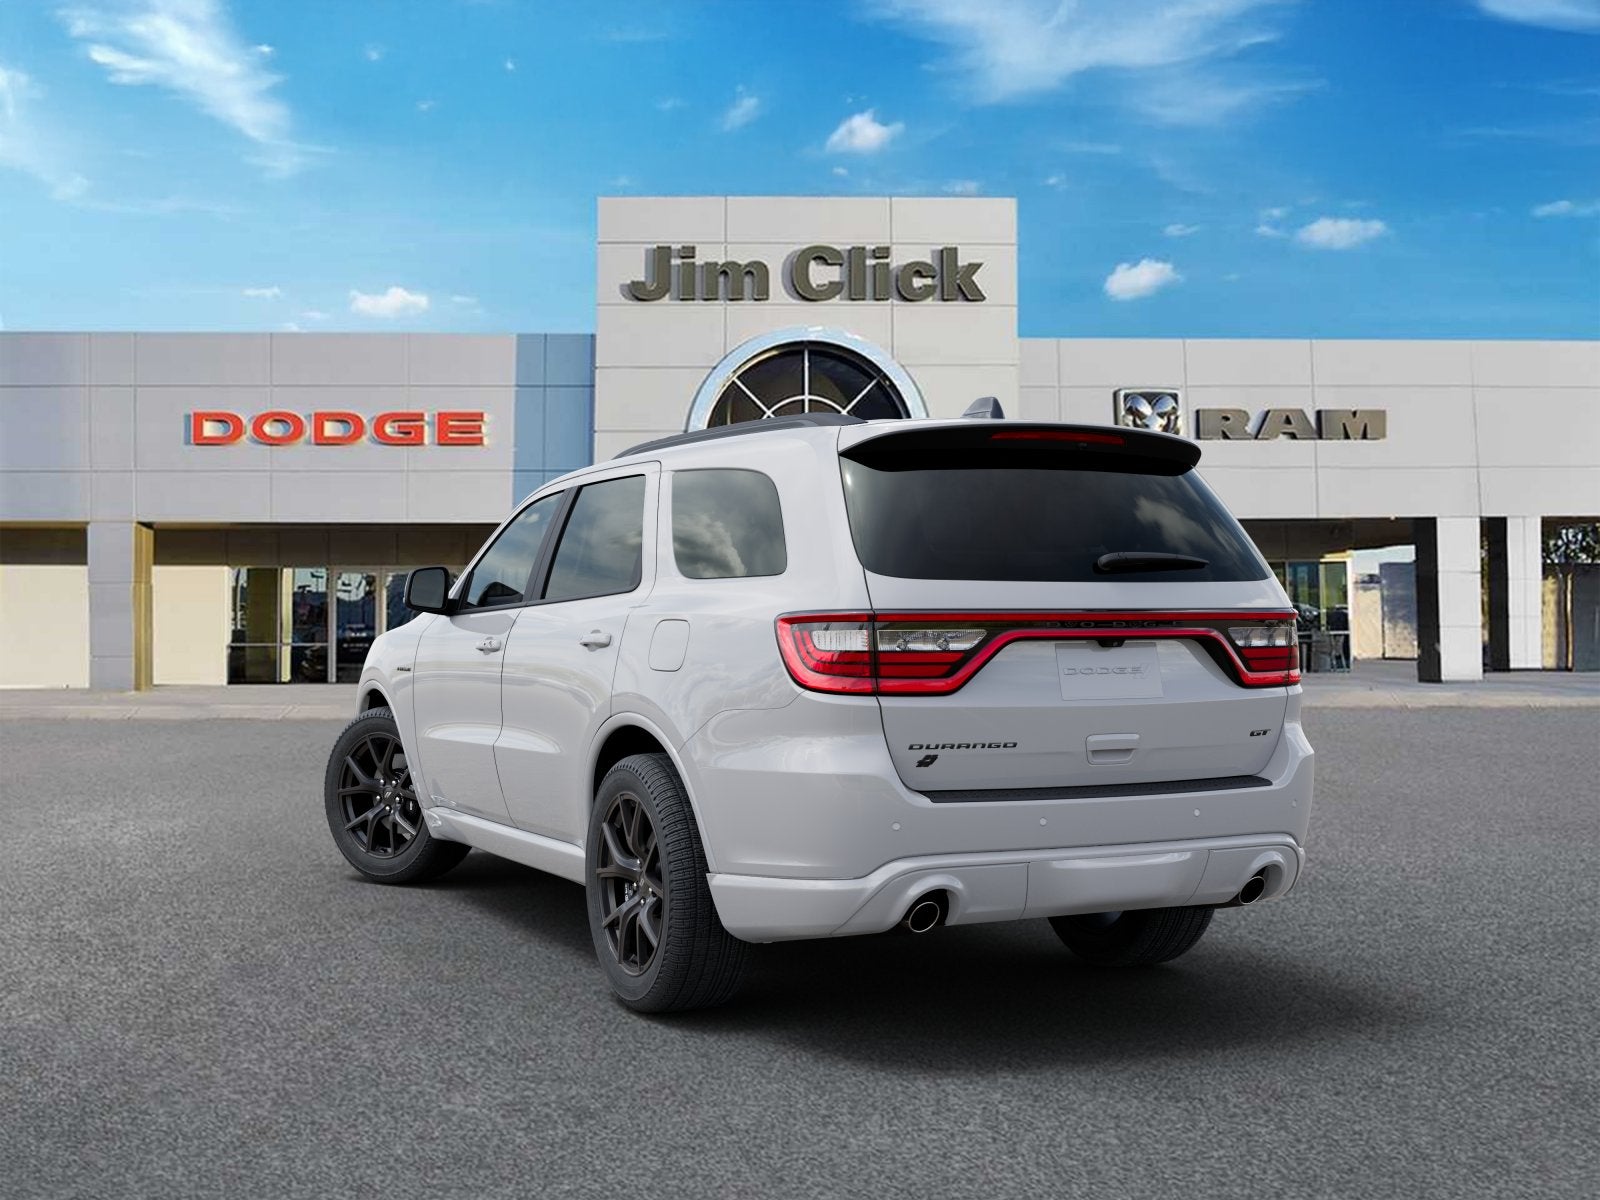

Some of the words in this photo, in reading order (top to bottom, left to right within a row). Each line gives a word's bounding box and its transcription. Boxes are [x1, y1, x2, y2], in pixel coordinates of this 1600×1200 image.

[627, 245, 769, 301] Jim
[790, 245, 986, 302] Click
[190, 411, 487, 446] DODGE
[1195, 409, 1387, 440] RAM
[1063, 667, 1143, 676] DODGE
[908, 742, 1018, 750] DURANGO
